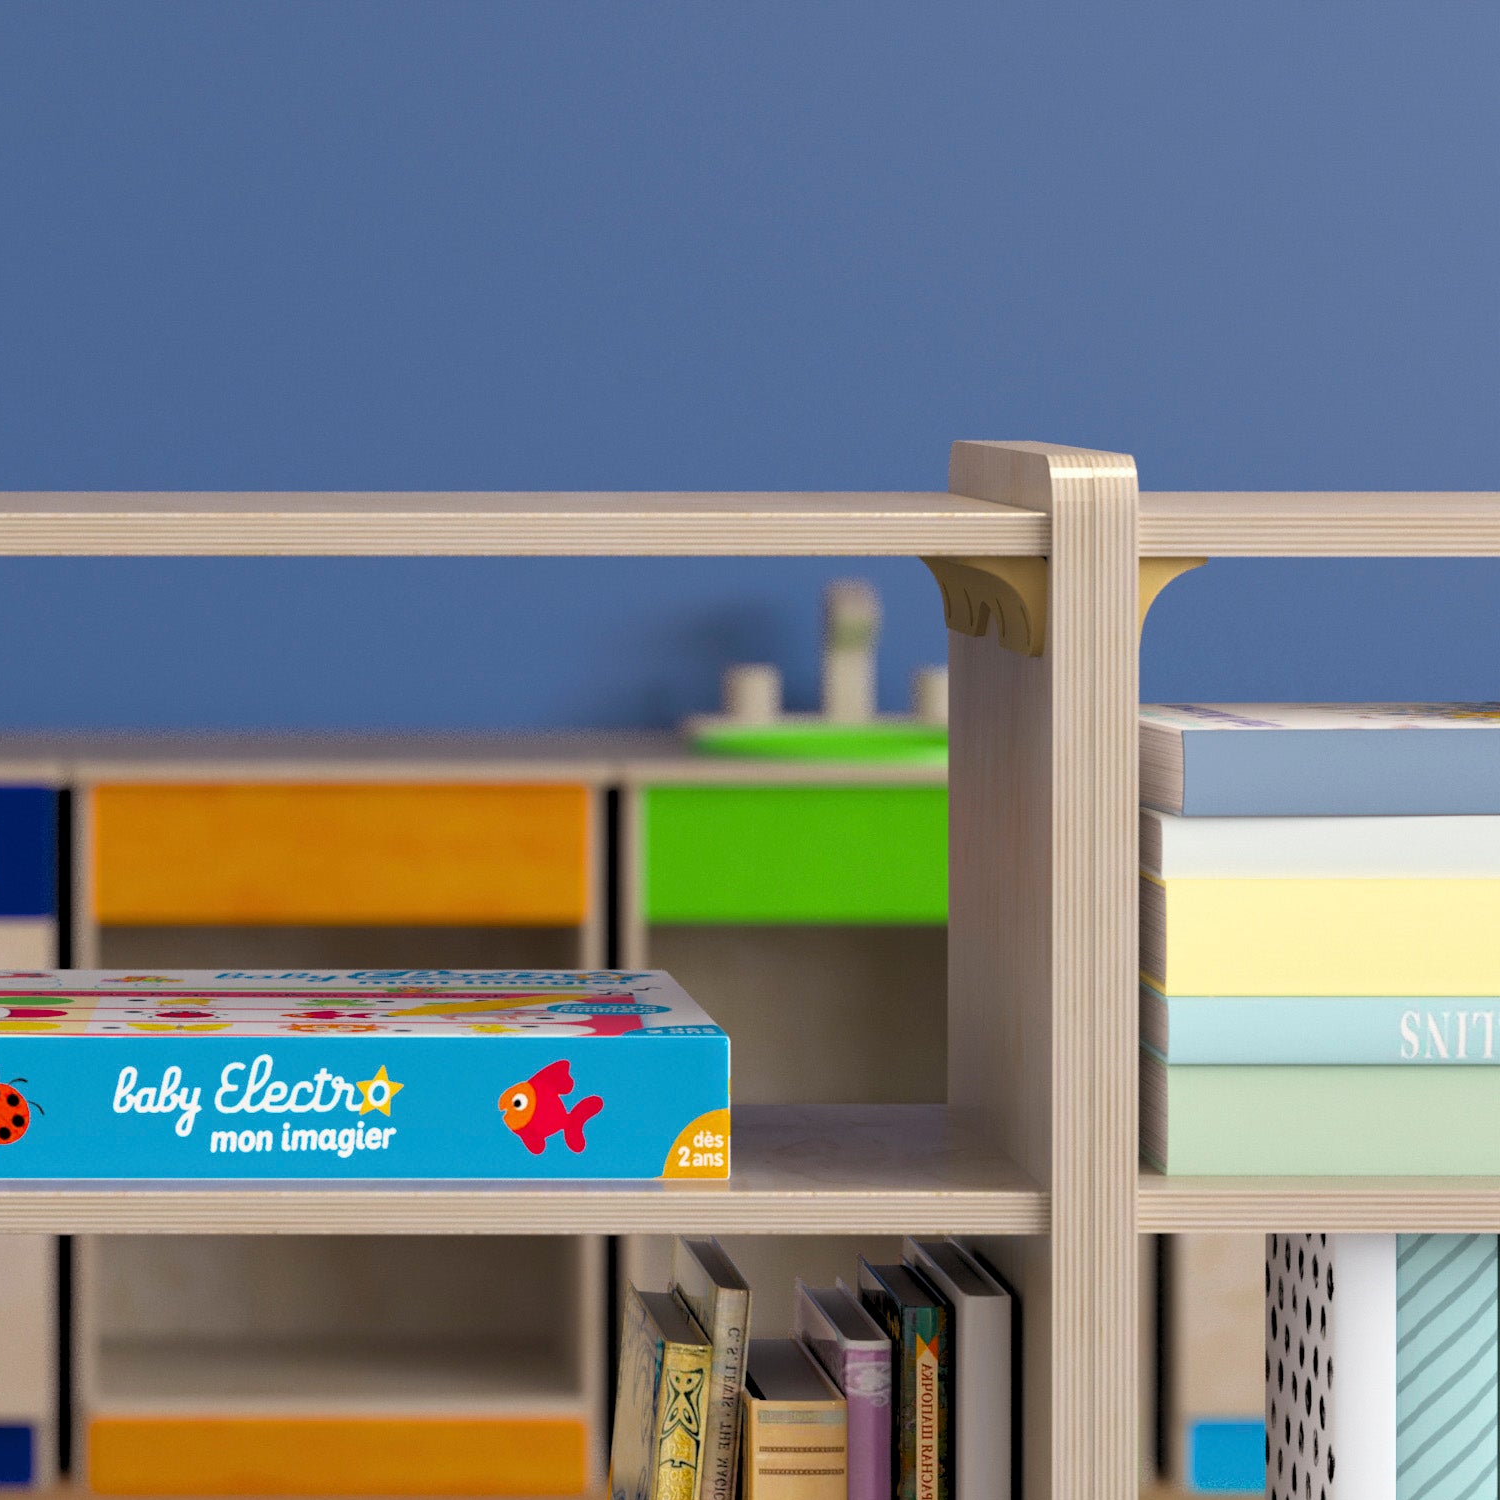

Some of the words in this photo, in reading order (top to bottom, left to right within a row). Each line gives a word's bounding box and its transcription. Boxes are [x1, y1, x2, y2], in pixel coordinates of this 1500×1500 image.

[1400, 1009, 1500, 1060] LINS
[112, 1065, 203, 1137] baby
[214, 1053, 405, 1117] Electro
[210, 1130, 273, 1153] mon
[281, 1120, 397, 1158] imagier
[677, 1145, 691, 1168] 2
[692, 1151, 725, 1168] ans
[693, 1130, 725, 1149] dès
